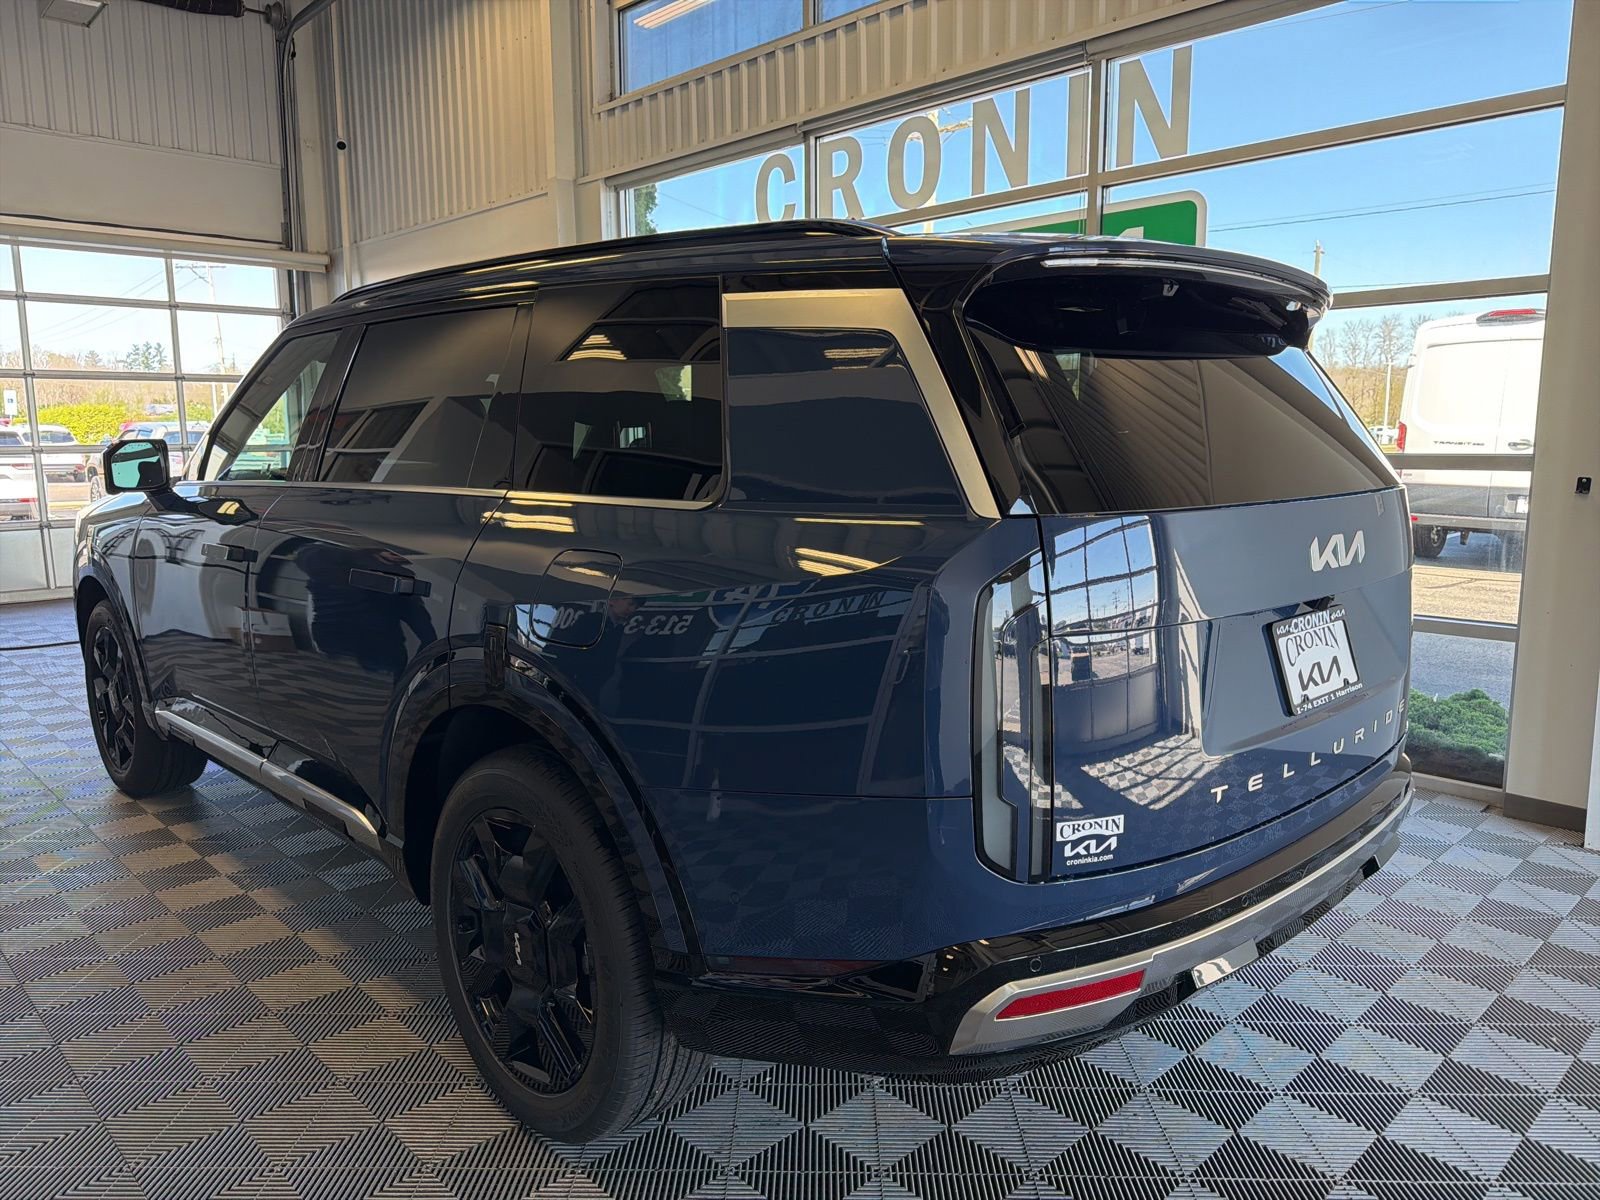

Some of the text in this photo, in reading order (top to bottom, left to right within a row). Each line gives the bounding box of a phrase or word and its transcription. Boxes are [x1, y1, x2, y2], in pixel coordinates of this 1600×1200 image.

[755, 45, 1193, 222] CRONIN
[1310, 529, 1366, 572] KIA
[1290, 609, 1331, 633] CRONIN
[1286, 623, 1340, 667] CRONIN
[1298, 655, 1342, 692] KIA
[1296, 702, 1313, 715] I-74
[1312, 695, 1330, 708] EXIT
[1335, 682, 1363, 699] Harrison
[1210, 698, 1405, 804] TELLURIDE
[1060, 817, 1121, 840] CRONIN
[1064, 835, 1118, 858] KIA
[1066, 853, 1114, 866] croninkia.com
